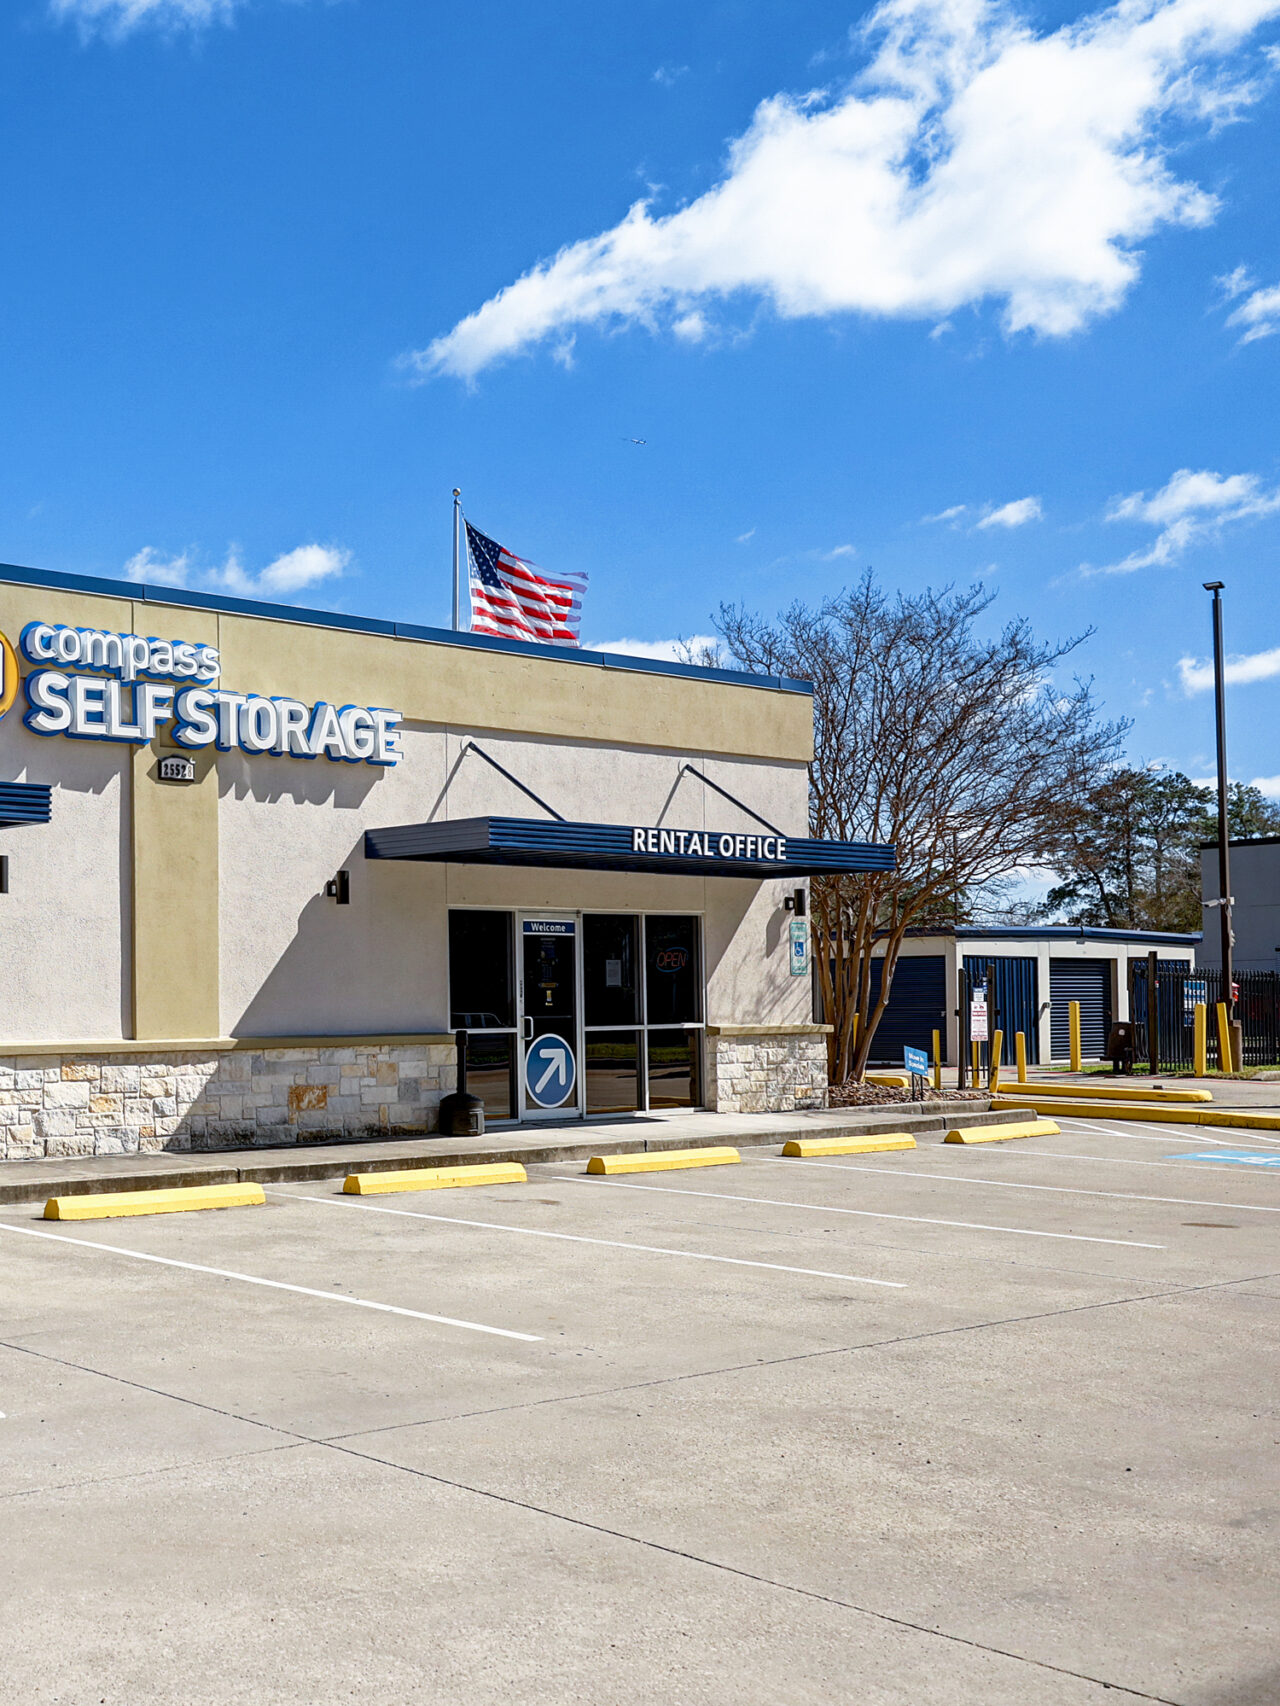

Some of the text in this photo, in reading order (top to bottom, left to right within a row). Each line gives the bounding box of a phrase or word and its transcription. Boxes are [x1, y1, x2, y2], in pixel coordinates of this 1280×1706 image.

[27, 621, 221, 681] compass
[29, 671, 404, 763] SELF STORAGE
[163, 763, 193, 778] 25528
[633, 828, 787, 860] RENTAL OFFICE
[531, 922, 566, 932] Welcome
[656, 951, 687, 967] OPEN
